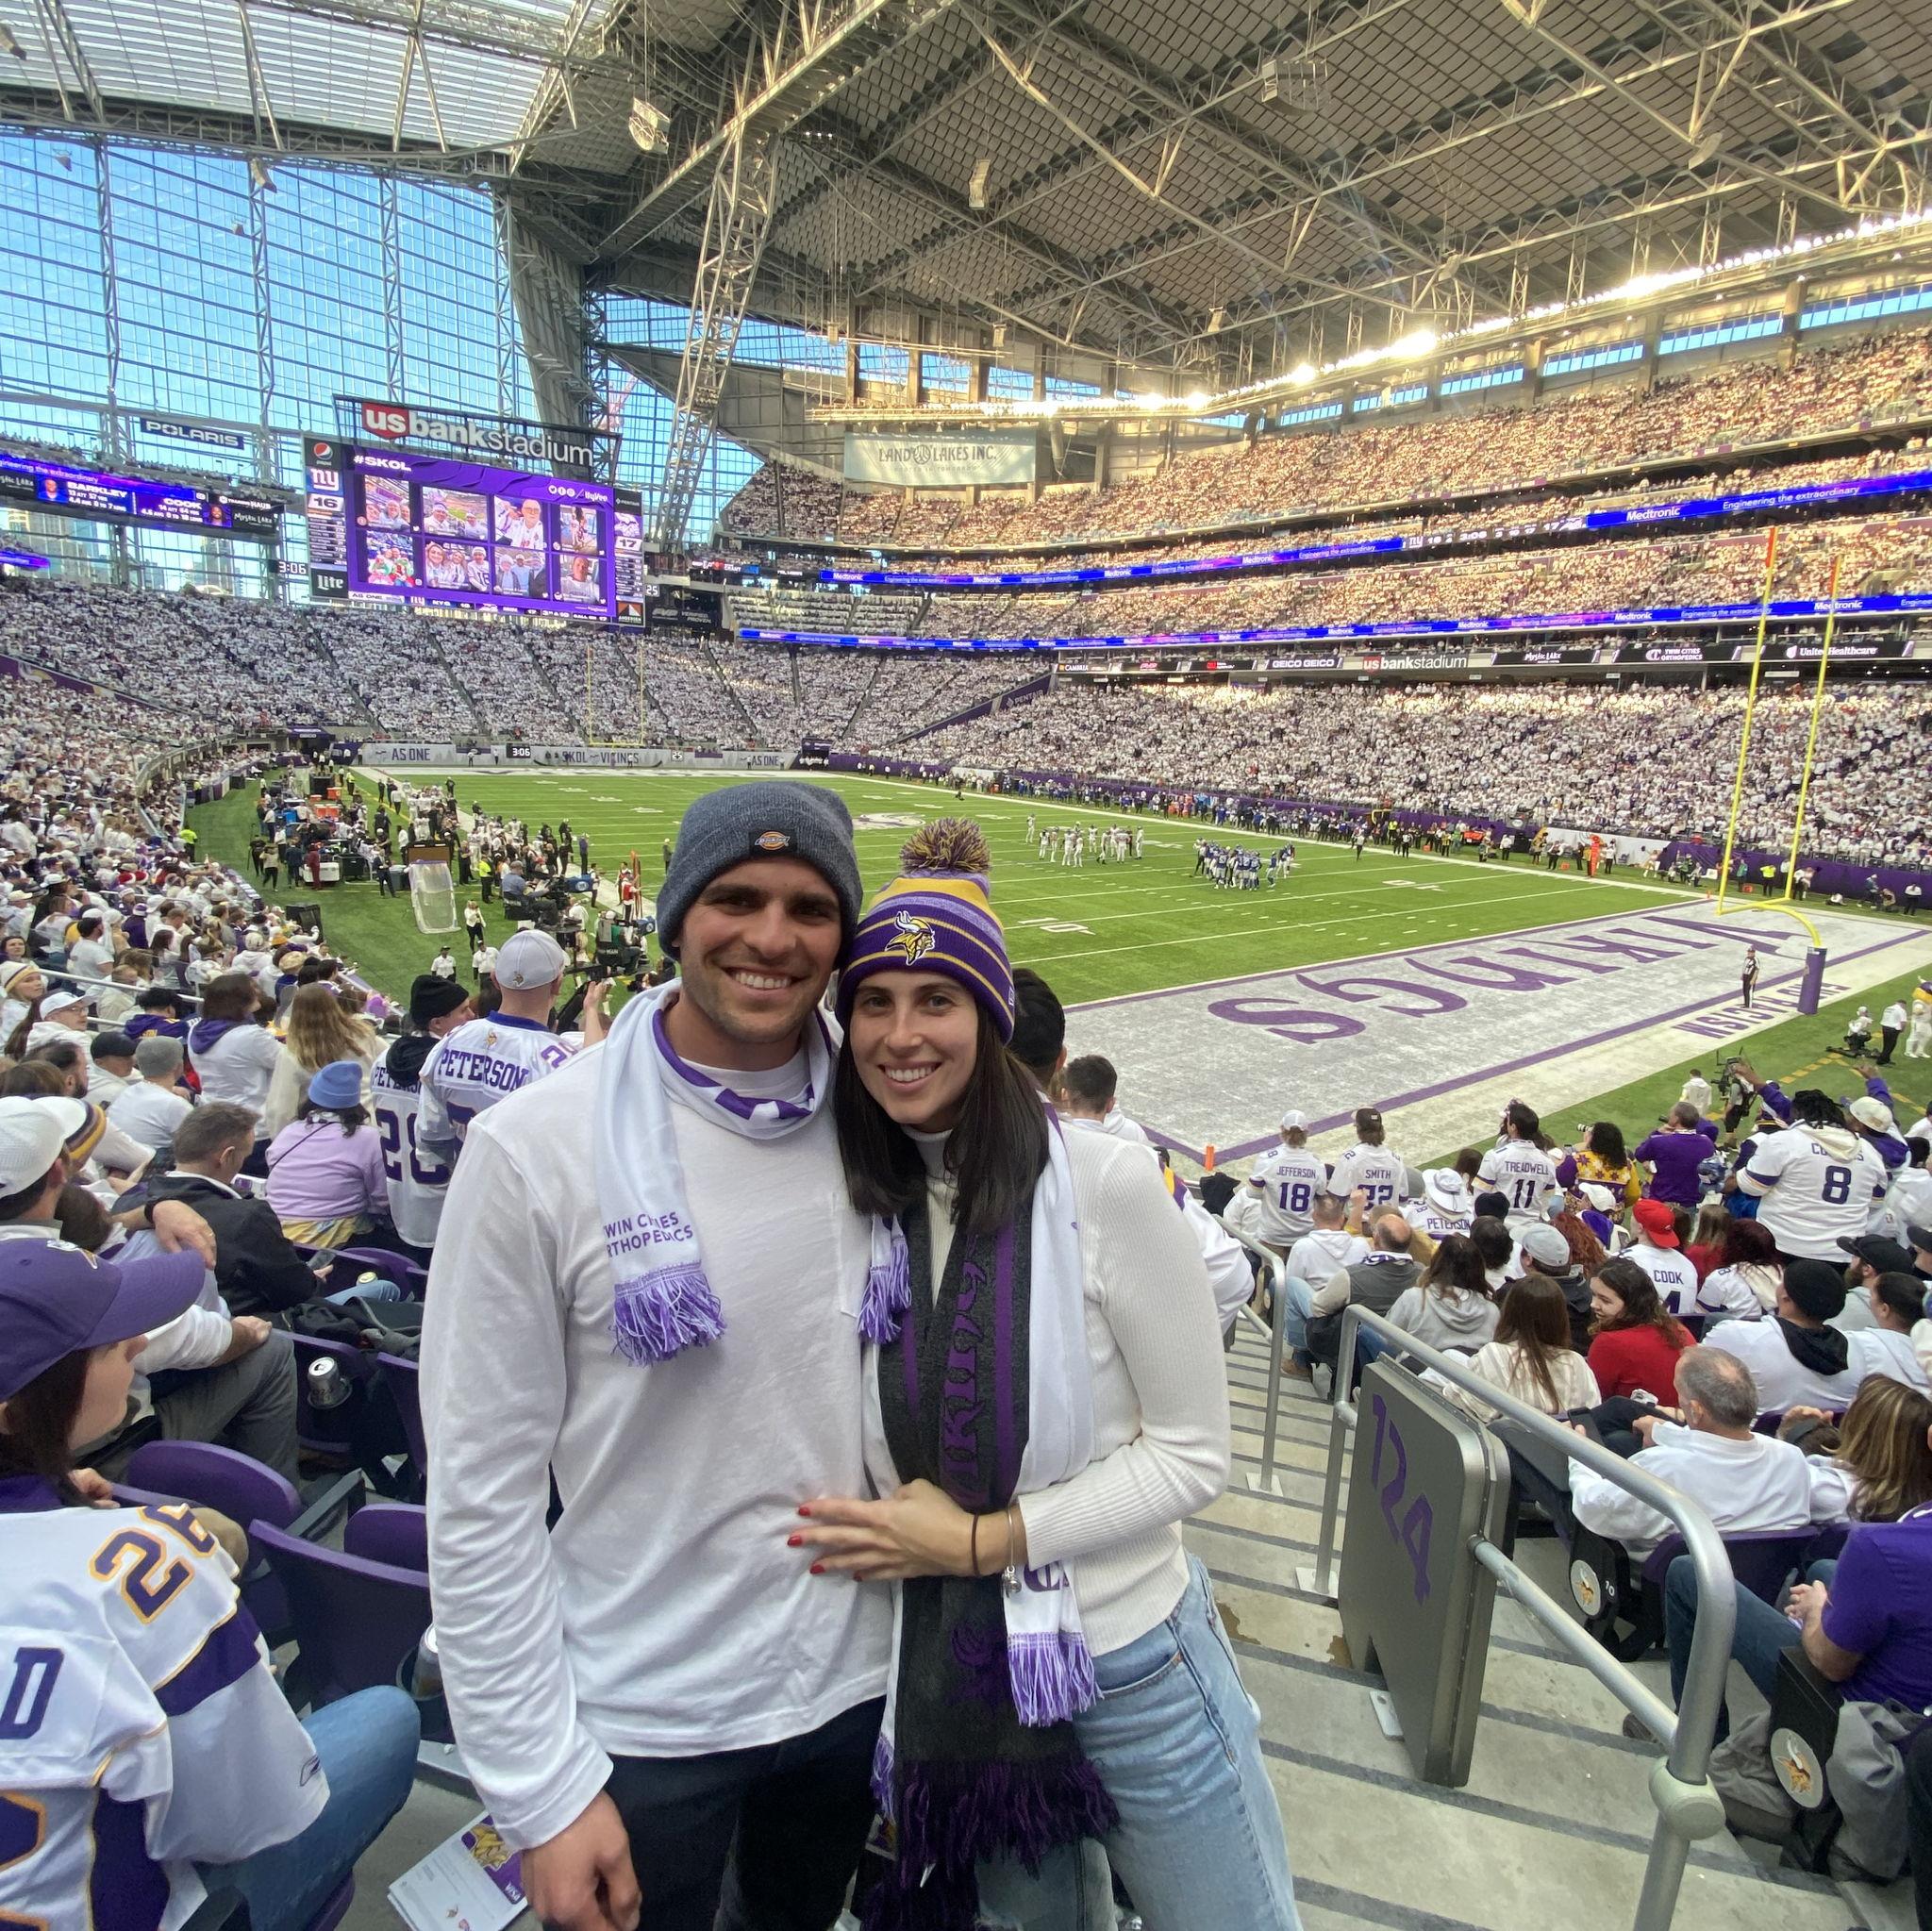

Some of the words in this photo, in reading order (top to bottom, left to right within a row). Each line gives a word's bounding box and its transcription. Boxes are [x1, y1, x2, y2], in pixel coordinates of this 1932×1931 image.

[146, 421, 239, 446] POLARIS
[879, 448, 911, 461] LAND
[933, 446, 968, 460] LAKES
[973, 444, 996, 460] INC.
[353, 455, 411, 472] #SKOL
[67, 481, 127, 497] BARKLEY
[163, 497, 202, 510] COOK
[313, 496, 339, 509] 16
[1723, 495, 1775, 510] Engineering
[1778, 492, 1793, 503] the
[1795, 486, 1859, 501] extraordinary
[1626, 507, 1681, 522] Medtronic
[1543, 522, 1559, 531] 17
[619, 539, 638, 549] 17
[1242, 556, 1274, 564] Medtronic
[278, 561, 307, 574] 3:06
[1105, 569, 1132, 577] Medtronic
[317, 574, 344, 591] Lite
[833, 573, 863, 581] Medtronic
[646, 584, 658, 596] 25
[1615, 611, 1653, 621] Medtronic
[1458, 620, 1489, 628] Medtronic
[1800, 646, 1878, 657] UniteHealthcare
[1273, 659, 1301, 668] GEICO
[1304, 658, 1334, 667] GEICO
[391, 748, 407, 760] AS
[408, 748, 430, 760] ONE
[512, 748, 530, 757] 3:06
[561, 751, 586, 763] SKOL
[763, 757, 780, 766] ONE
[1208, 916, 1810, 1044] VIKINGS
[437, 1049, 529, 1091] PETERSON
[1276, 1166, 1316, 1178] JEFFERSON
[1365, 1170, 1391, 1179] SMITH
[1506, 1161, 1549, 1175] TREADWELL
[1822, 1165, 1852, 1205] 8
[1279, 1182, 1311, 1212] 18
[1513, 1179, 1536, 1208] 11
[1654, 1270, 1684, 1285] COOK
[1372, 1393, 1433, 1607] 124
[1606, 1580, 1616, 1596] 10
